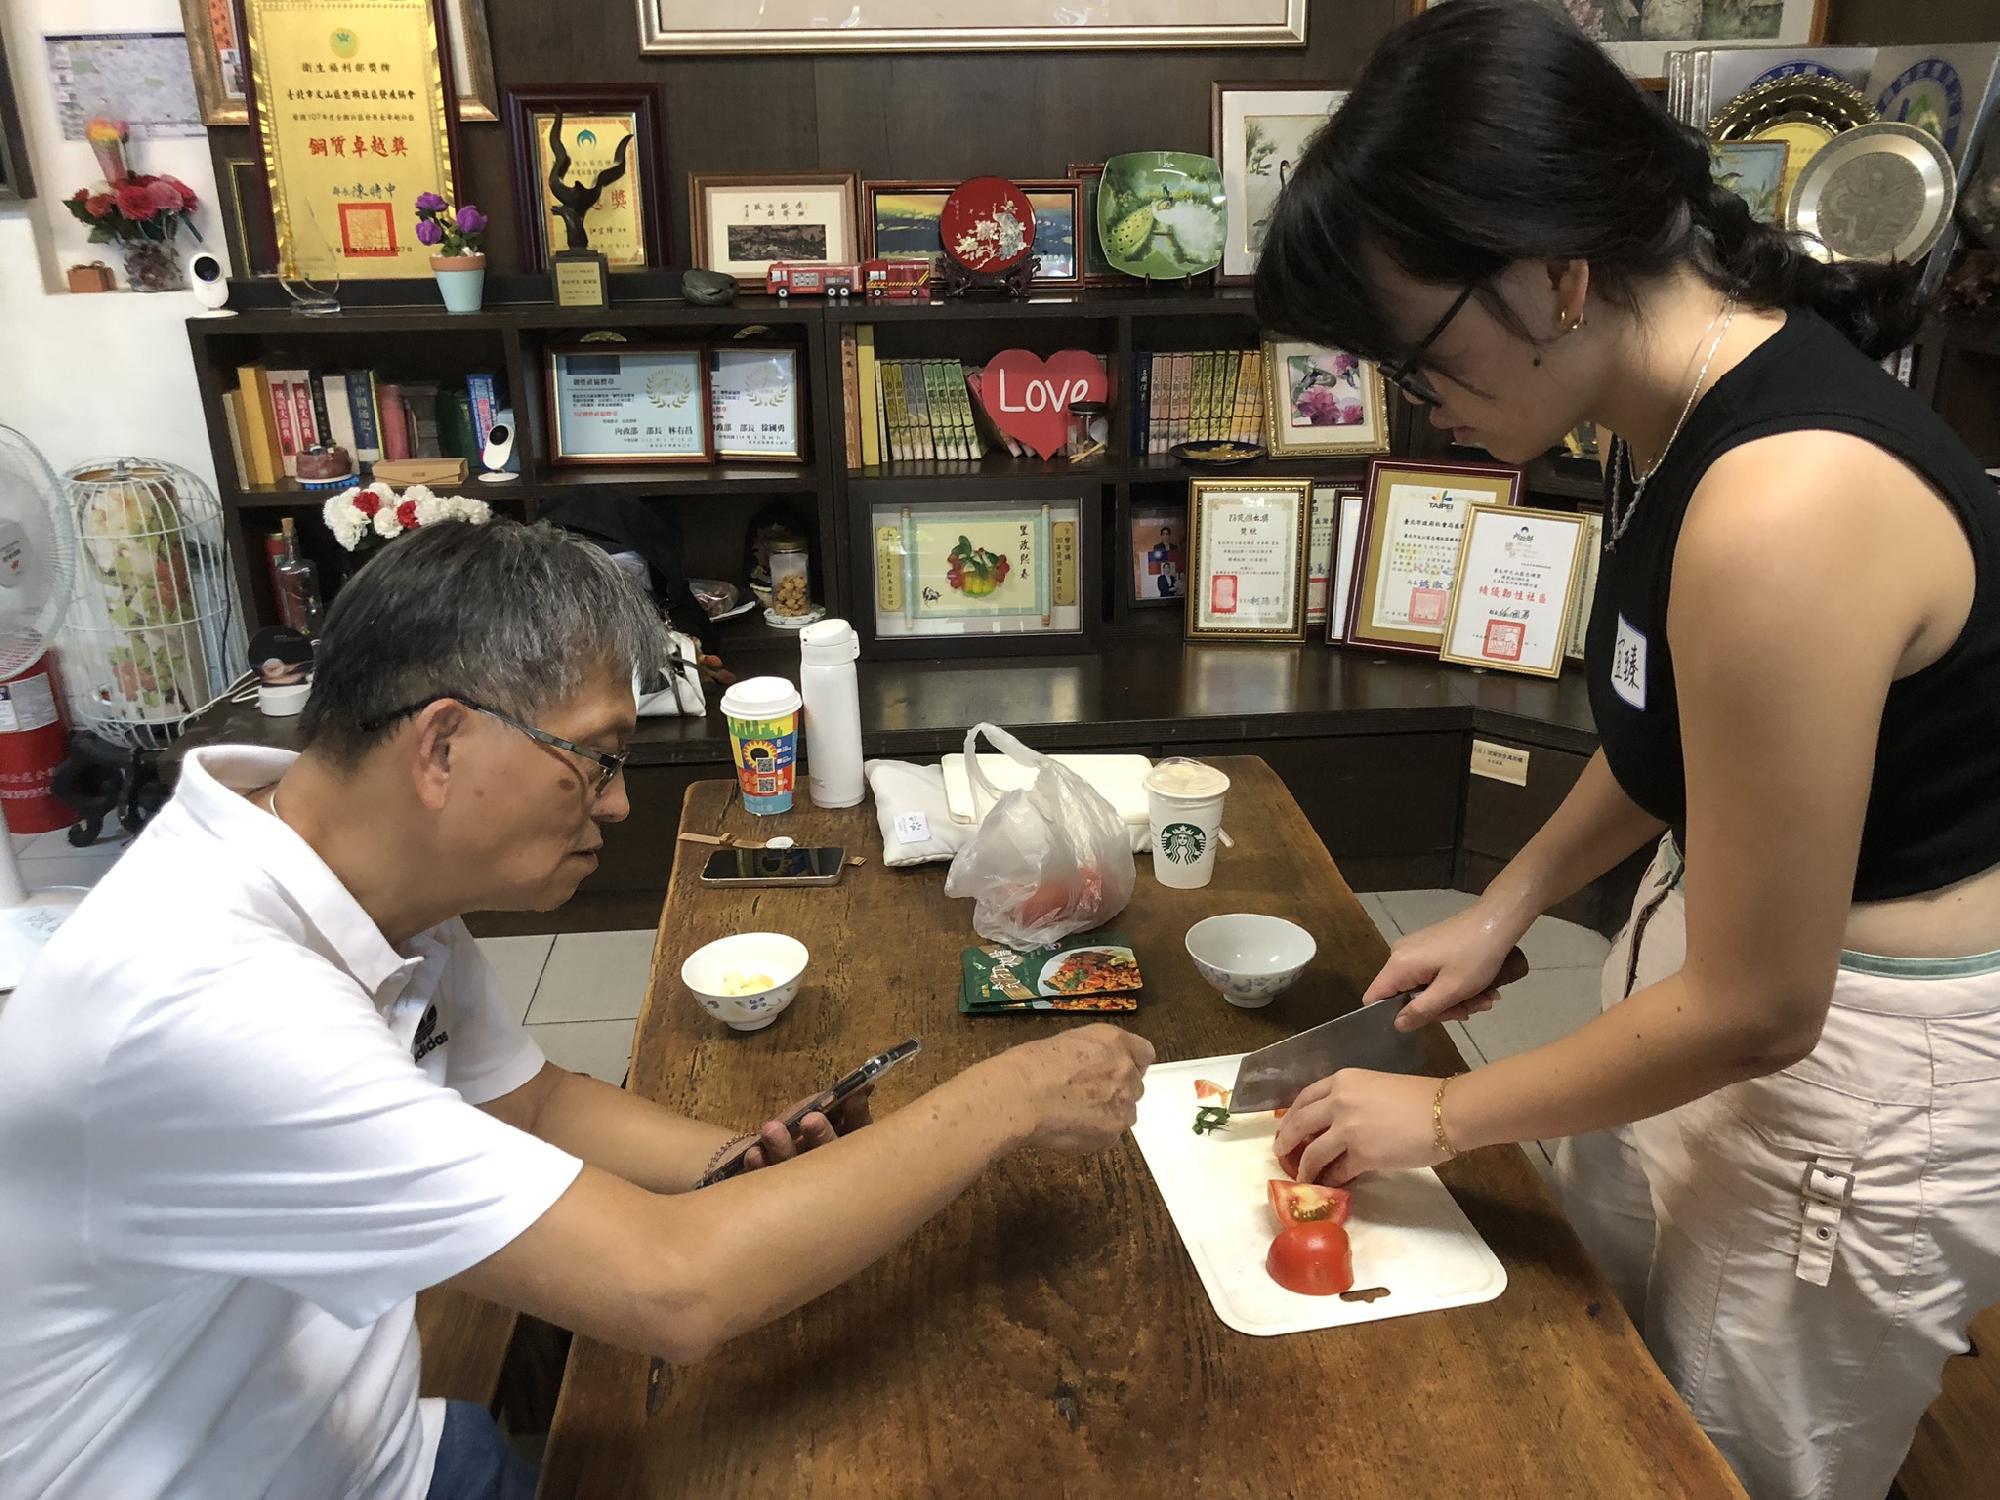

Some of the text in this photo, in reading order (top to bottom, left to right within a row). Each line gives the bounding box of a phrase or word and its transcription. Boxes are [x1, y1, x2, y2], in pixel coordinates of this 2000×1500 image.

[308, 134, 409, 159] 銅質卓越獎
[999, 368, 1089, 413] Love
[1428, 502, 1454, 511] TAIPEI
